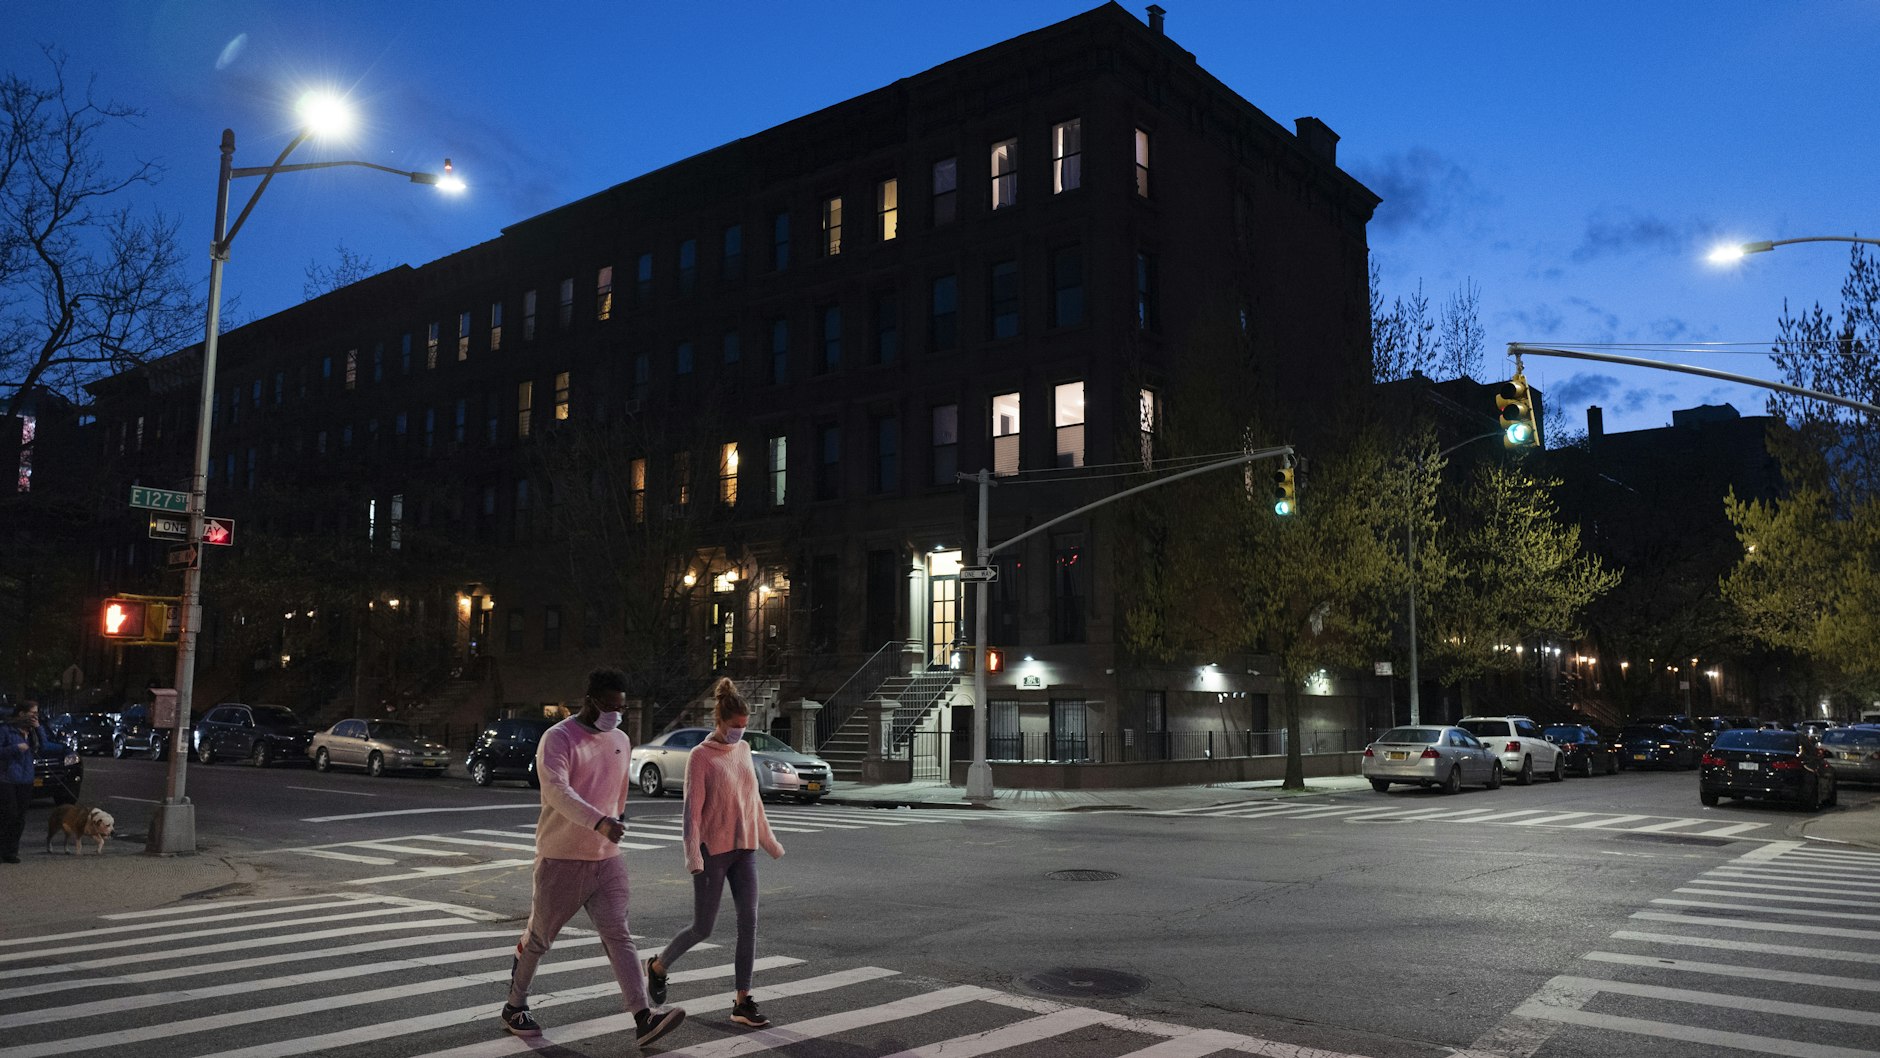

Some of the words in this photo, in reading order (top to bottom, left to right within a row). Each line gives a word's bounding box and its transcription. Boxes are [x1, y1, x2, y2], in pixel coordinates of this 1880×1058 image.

[131, 489, 142, 505] E
[146, 492, 172, 508] 127
[175, 494, 187, 503] ST
[163, 521, 187, 532] ONE
[203, 525, 220, 536] AY
